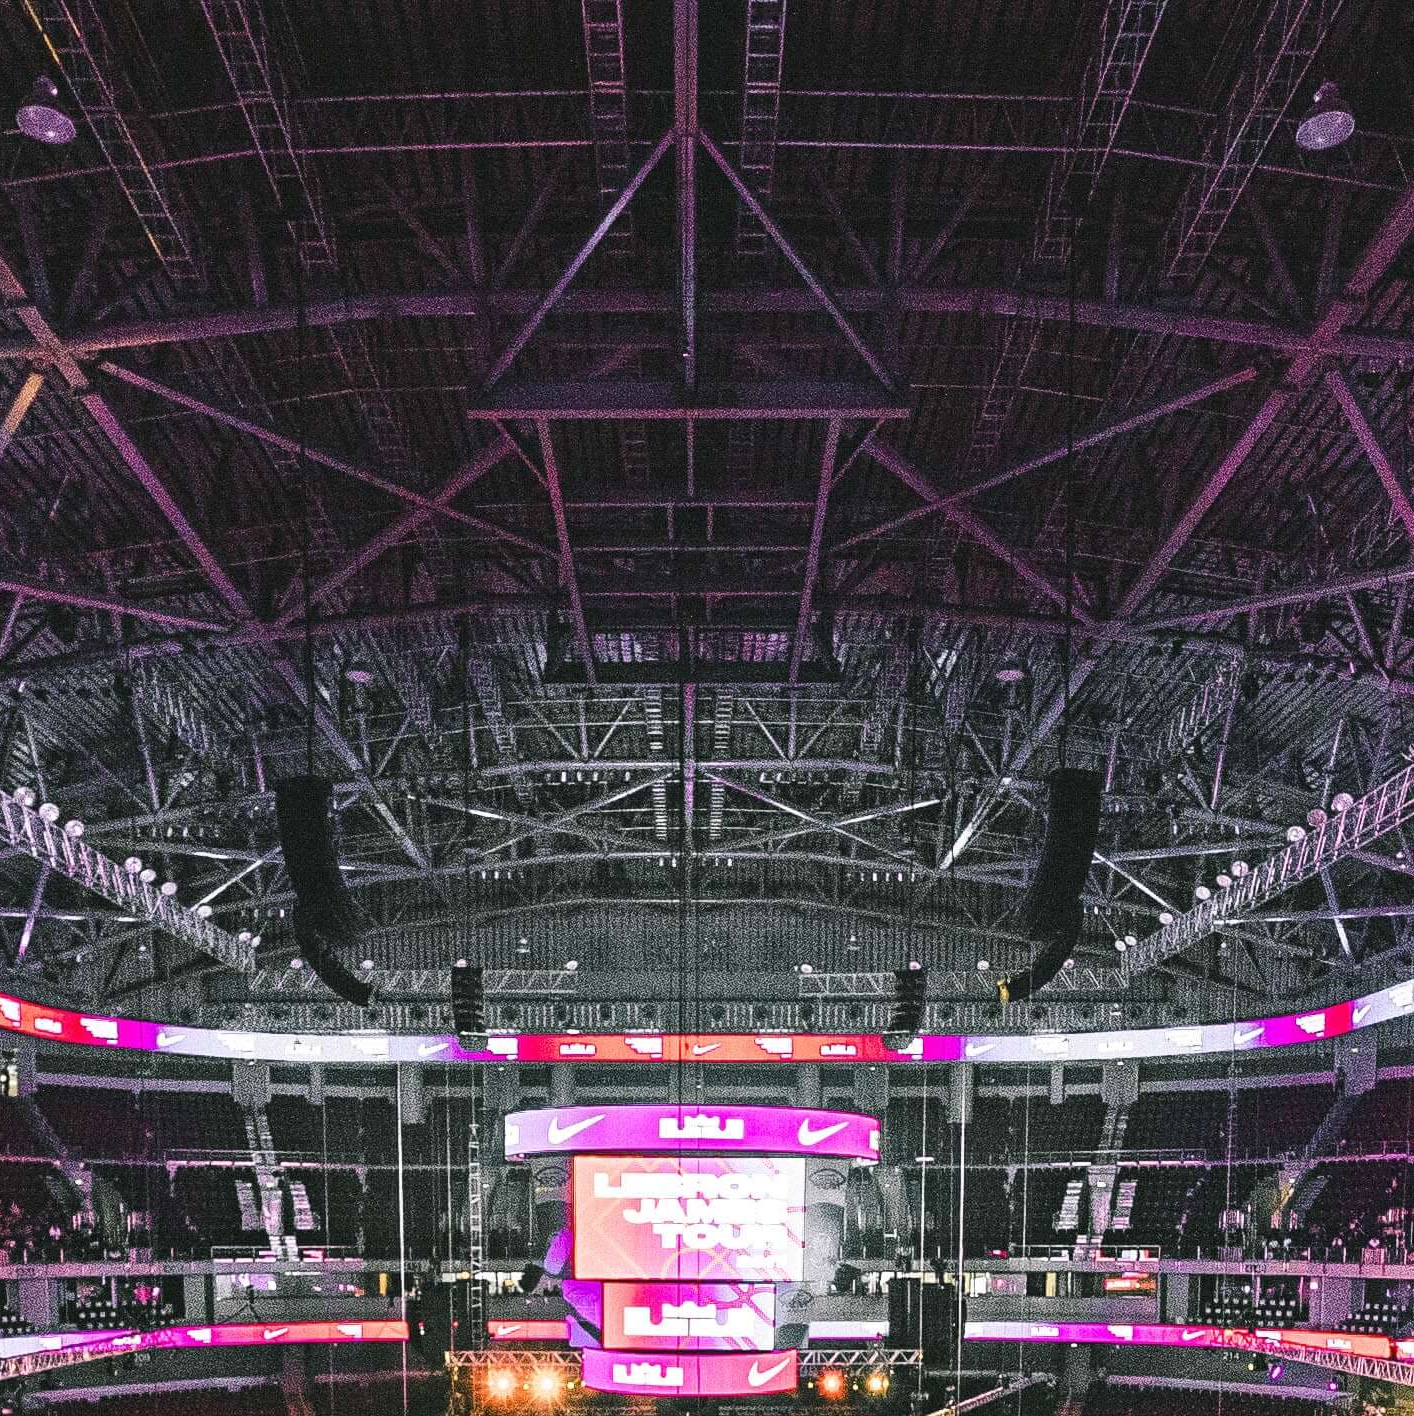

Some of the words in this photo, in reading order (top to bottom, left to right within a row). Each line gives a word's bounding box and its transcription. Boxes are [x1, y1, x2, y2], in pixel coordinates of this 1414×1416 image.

[594, 1173, 786, 1199] LEBRON
[623, 1200, 787, 1224] JAMES
[653, 1224, 787, 1249] TOUR
